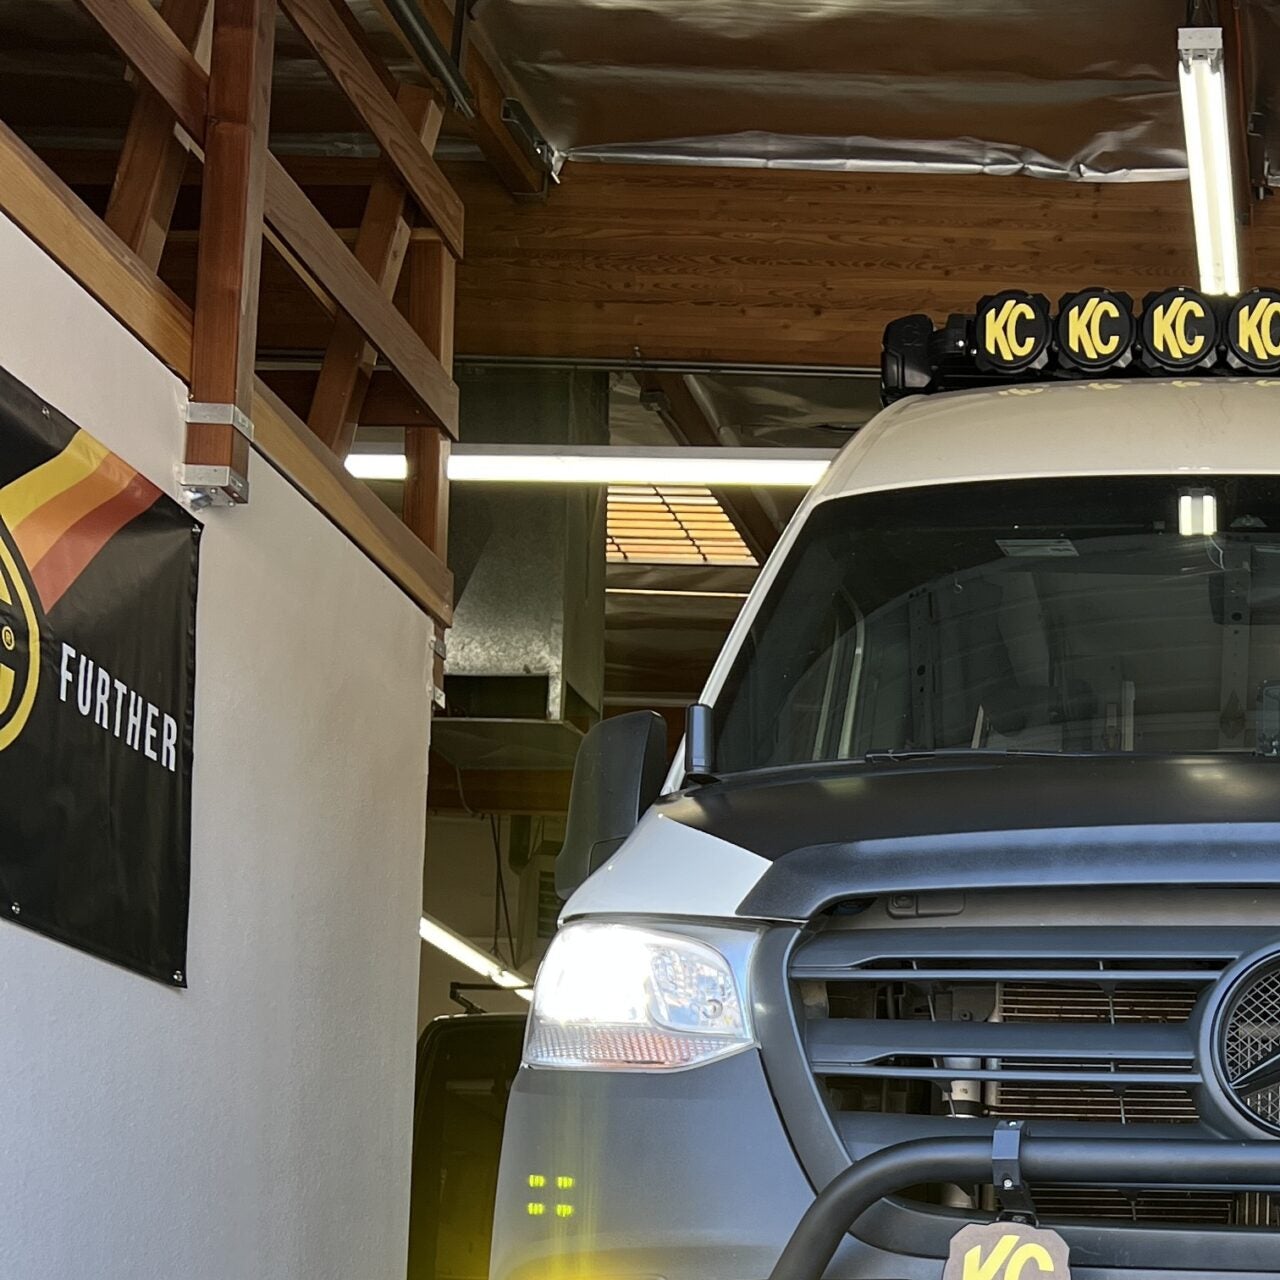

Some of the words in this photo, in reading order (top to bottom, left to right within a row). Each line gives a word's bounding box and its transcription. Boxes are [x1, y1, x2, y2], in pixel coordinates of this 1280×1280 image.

[986, 300, 1035, 360] KC
[1069, 299, 1119, 358] KC
[1154, 299, 1204, 358] KC
[59, 642, 178, 772] FURTHER
